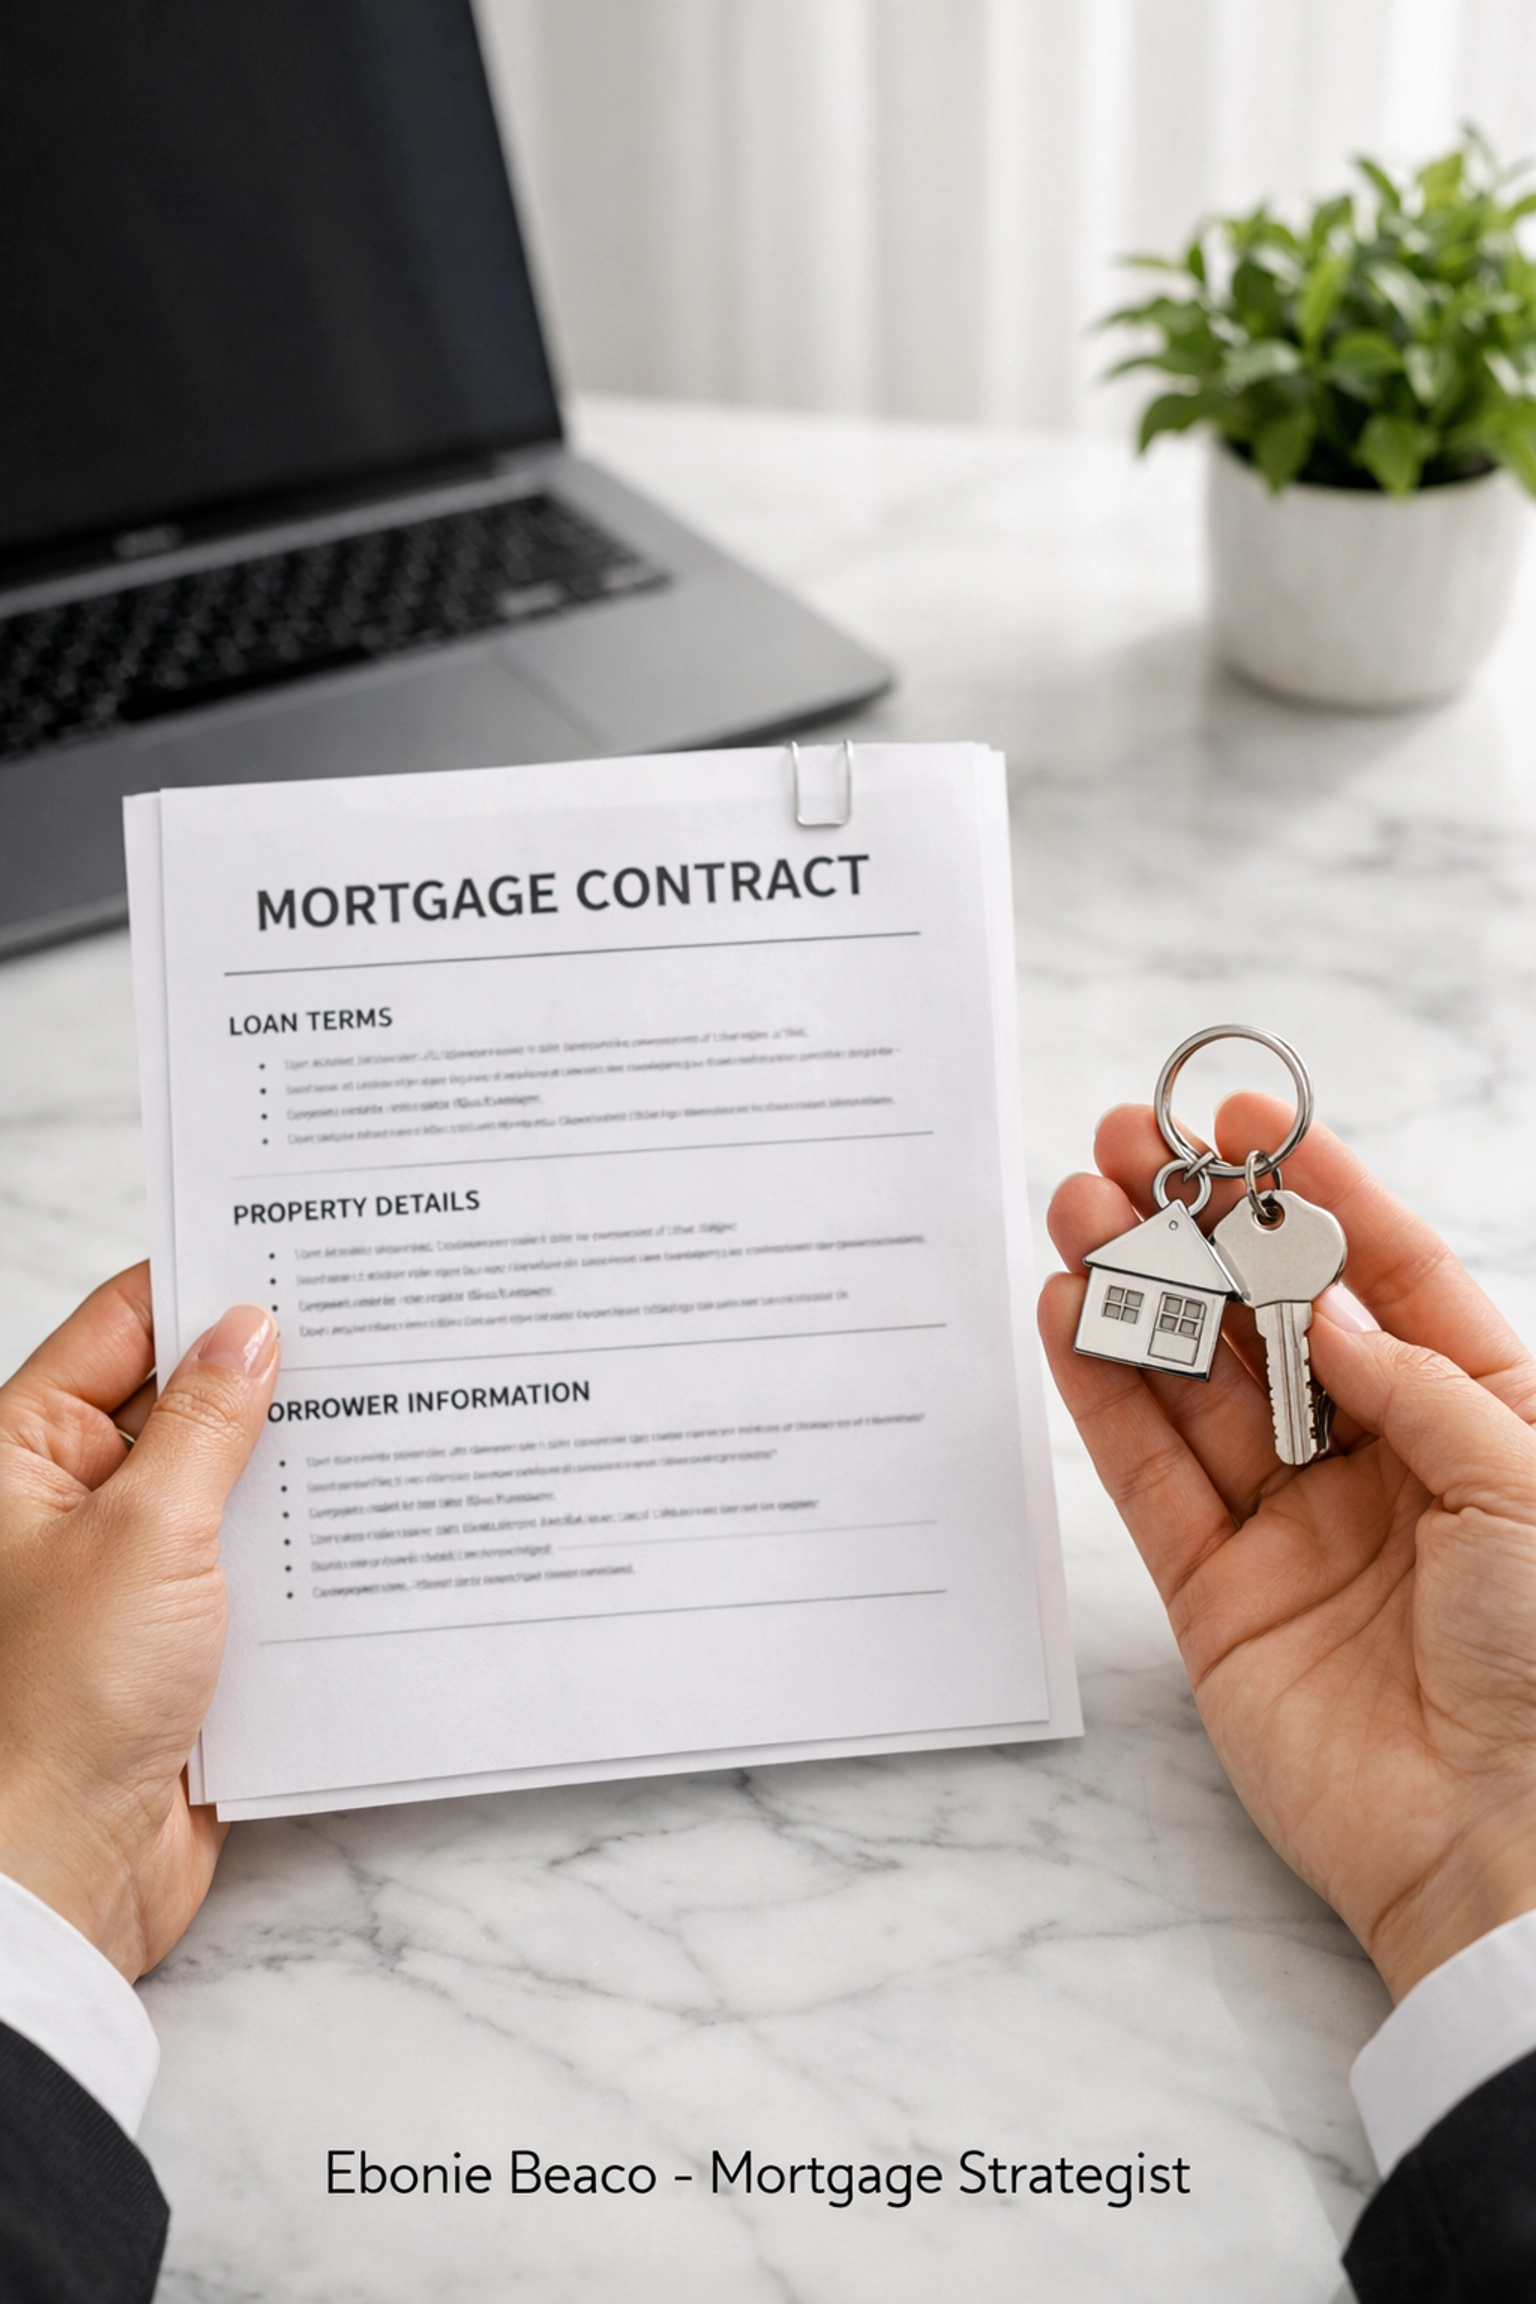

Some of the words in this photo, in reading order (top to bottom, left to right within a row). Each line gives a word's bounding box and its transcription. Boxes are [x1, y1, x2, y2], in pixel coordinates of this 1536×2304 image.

[257, 872, 558, 932] MORTGAGE
[576, 854, 871, 911] CONTRACT
[229, 1012, 298, 1036] LOAN
[306, 1007, 393, 1031] TERMS
[233, 1197, 367, 1226] PROPERTY
[375, 1189, 480, 1217] DETAILS
[267, 1393, 399, 1423] ORROWER
[408, 1380, 590, 1414] INFORMATION
